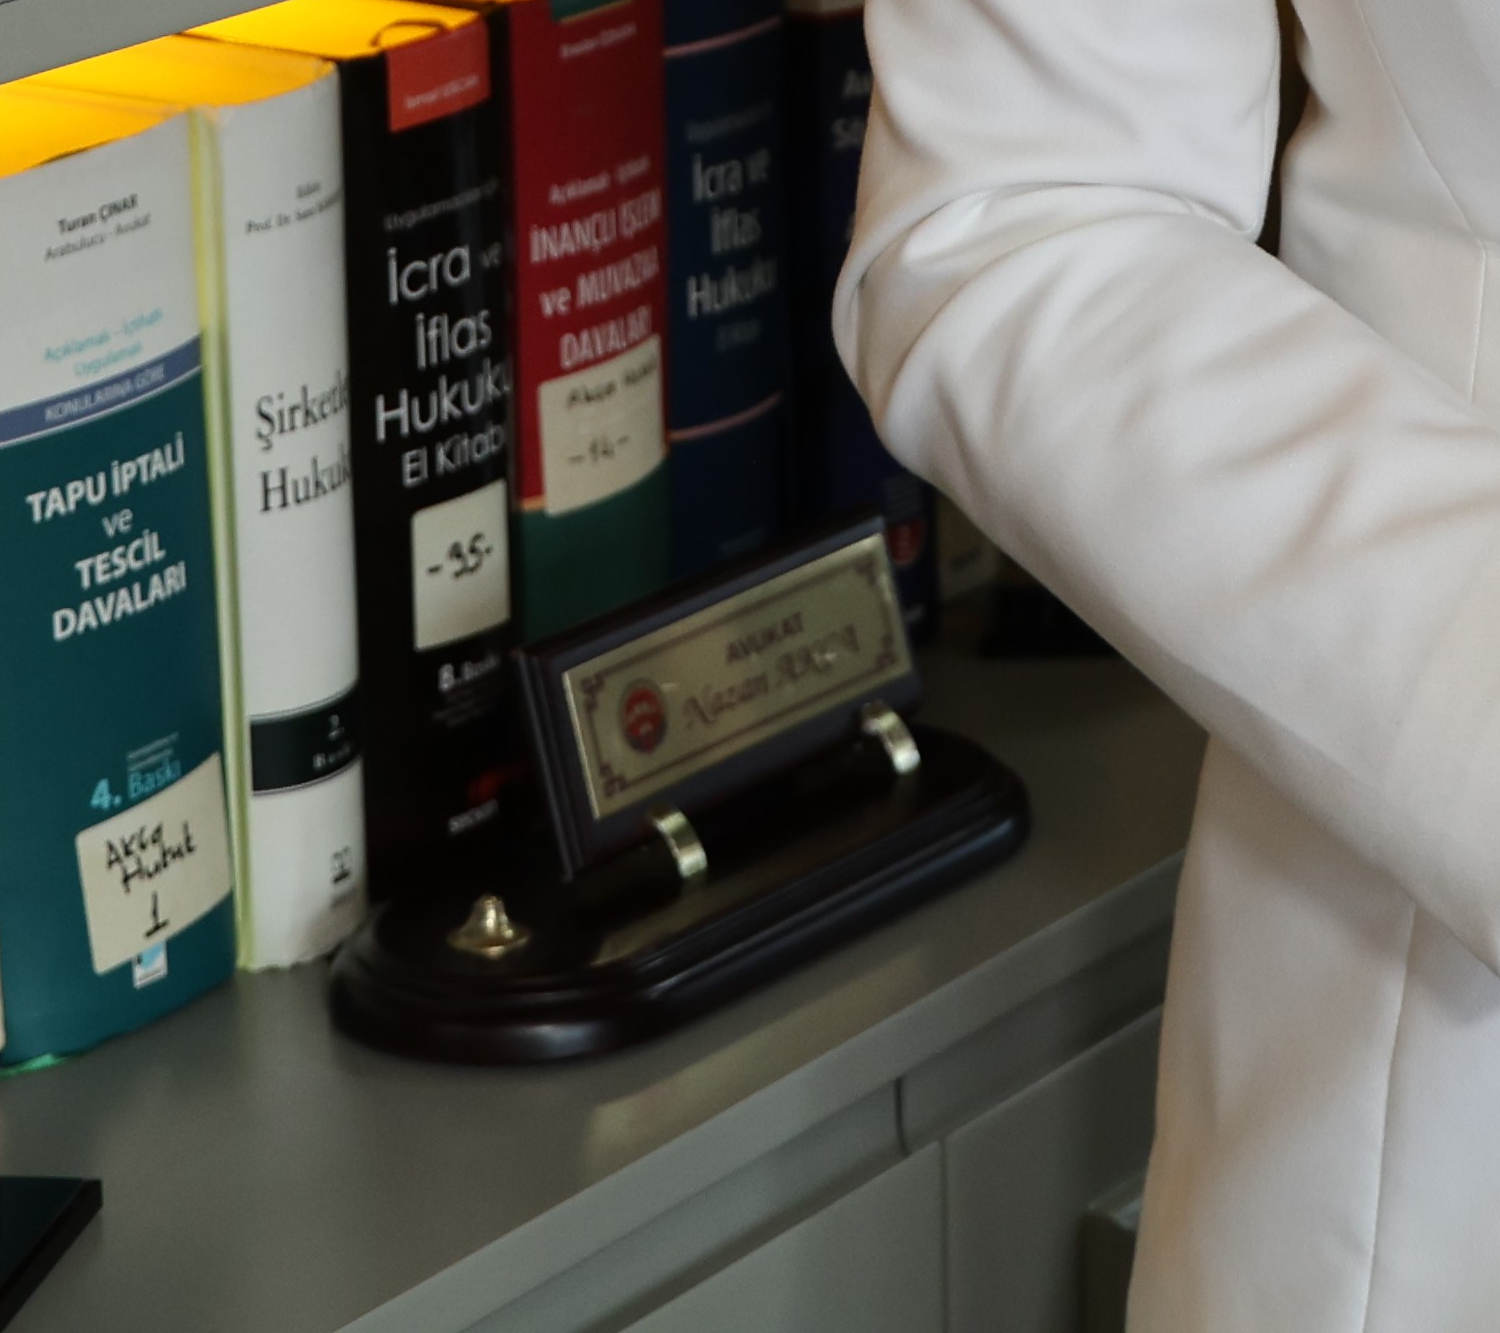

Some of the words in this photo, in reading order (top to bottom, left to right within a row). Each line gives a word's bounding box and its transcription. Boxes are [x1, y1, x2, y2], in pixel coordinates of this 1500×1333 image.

[387, 244, 472, 306] İcra
[416, 309, 493, 371] İflas
[25, 477, 106, 525] TAPU
[111, 431, 186, 493] İPTALİ
[102, 506, 134, 538] ve
[75, 527, 167, 593] TESCİL
[52, 562, 188, 643] DAVALARI
